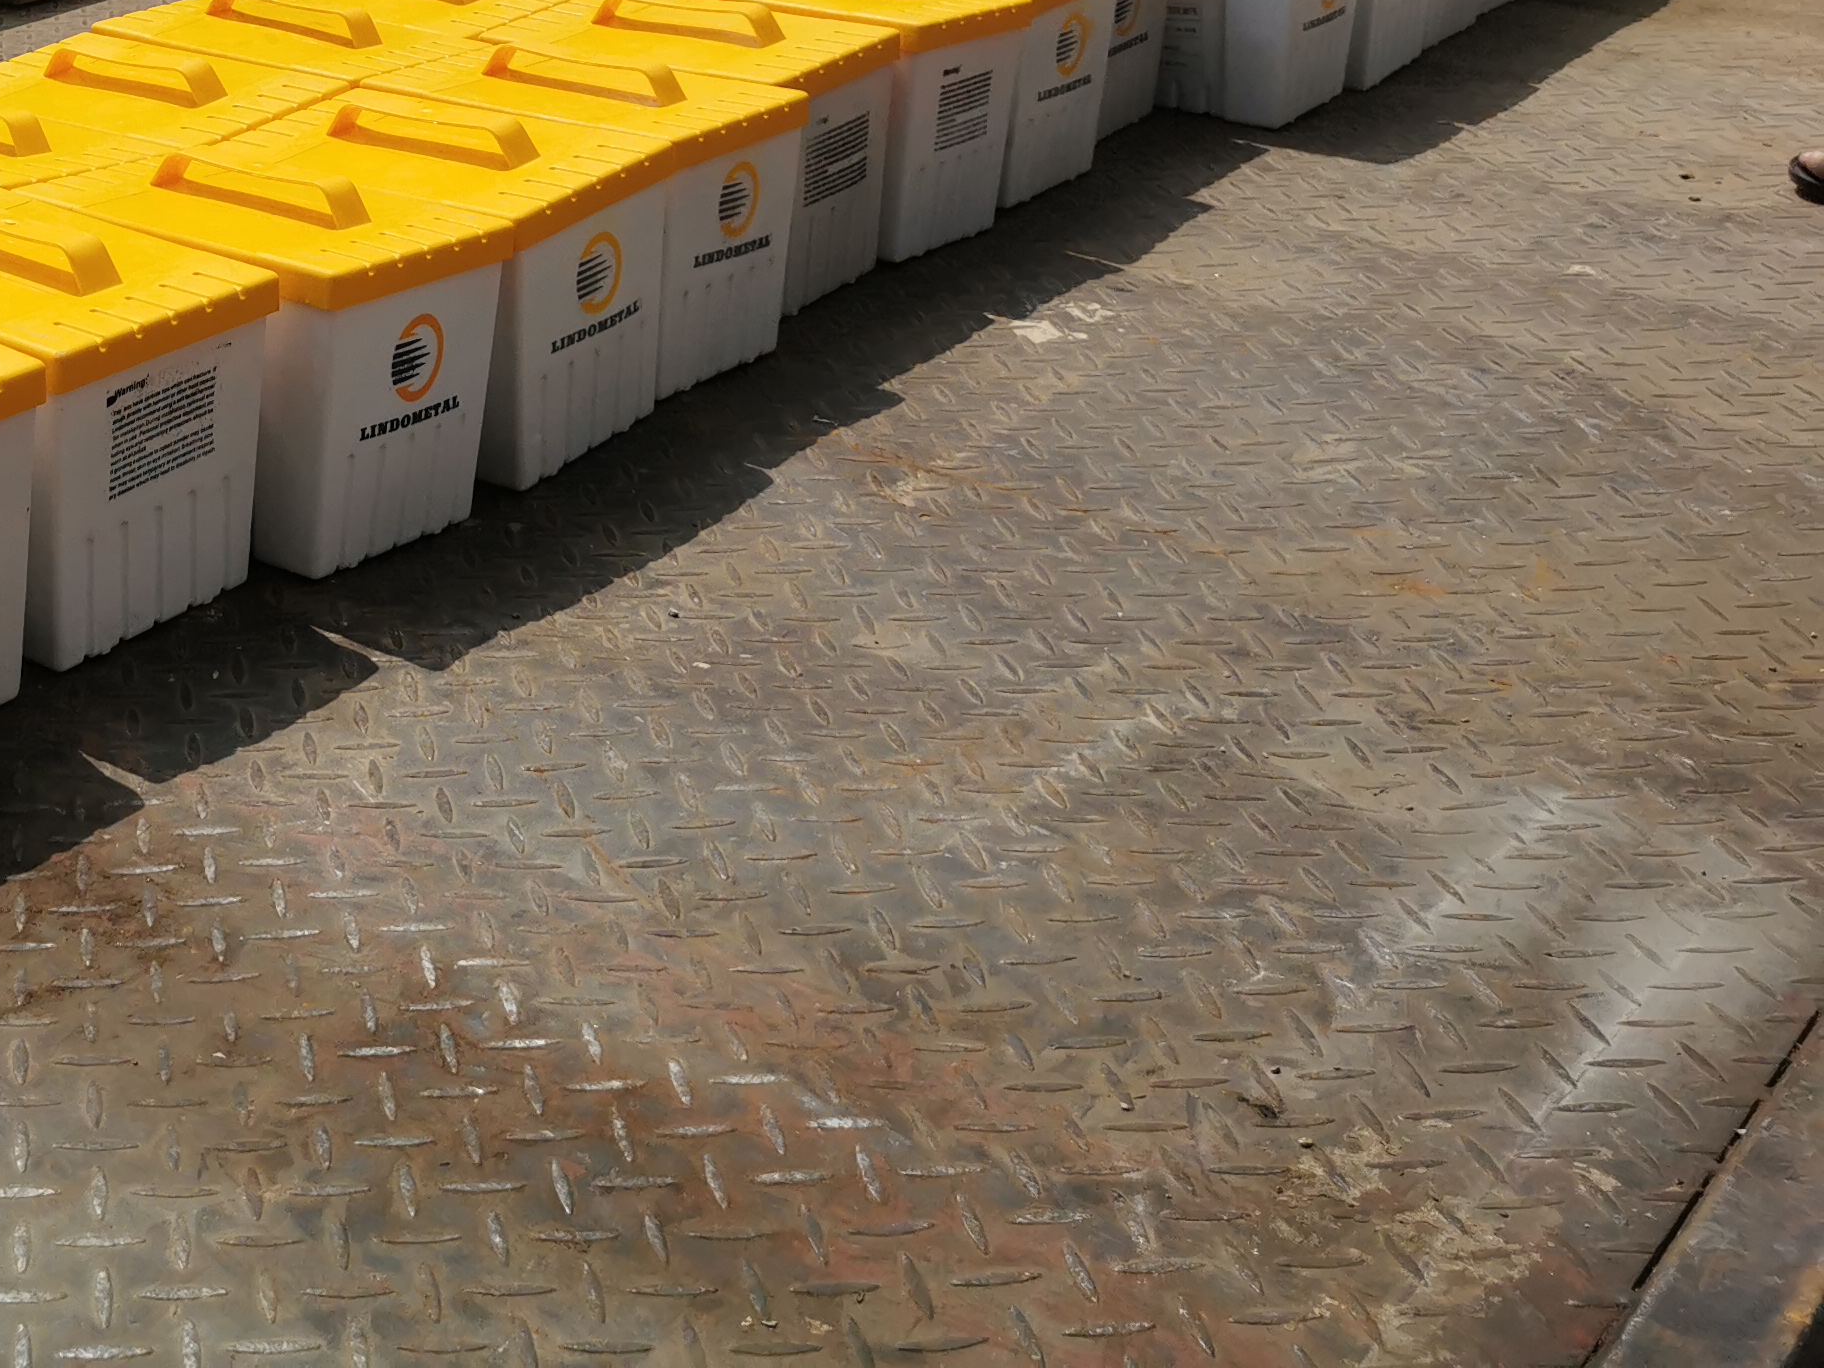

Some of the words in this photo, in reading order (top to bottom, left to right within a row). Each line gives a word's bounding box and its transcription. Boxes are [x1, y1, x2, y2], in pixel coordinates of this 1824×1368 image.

[693, 234, 771, 268] LINDOMETAL
[550, 299, 641, 354] LINDOMETAL
[359, 395, 460, 441] LINDOMETAL
